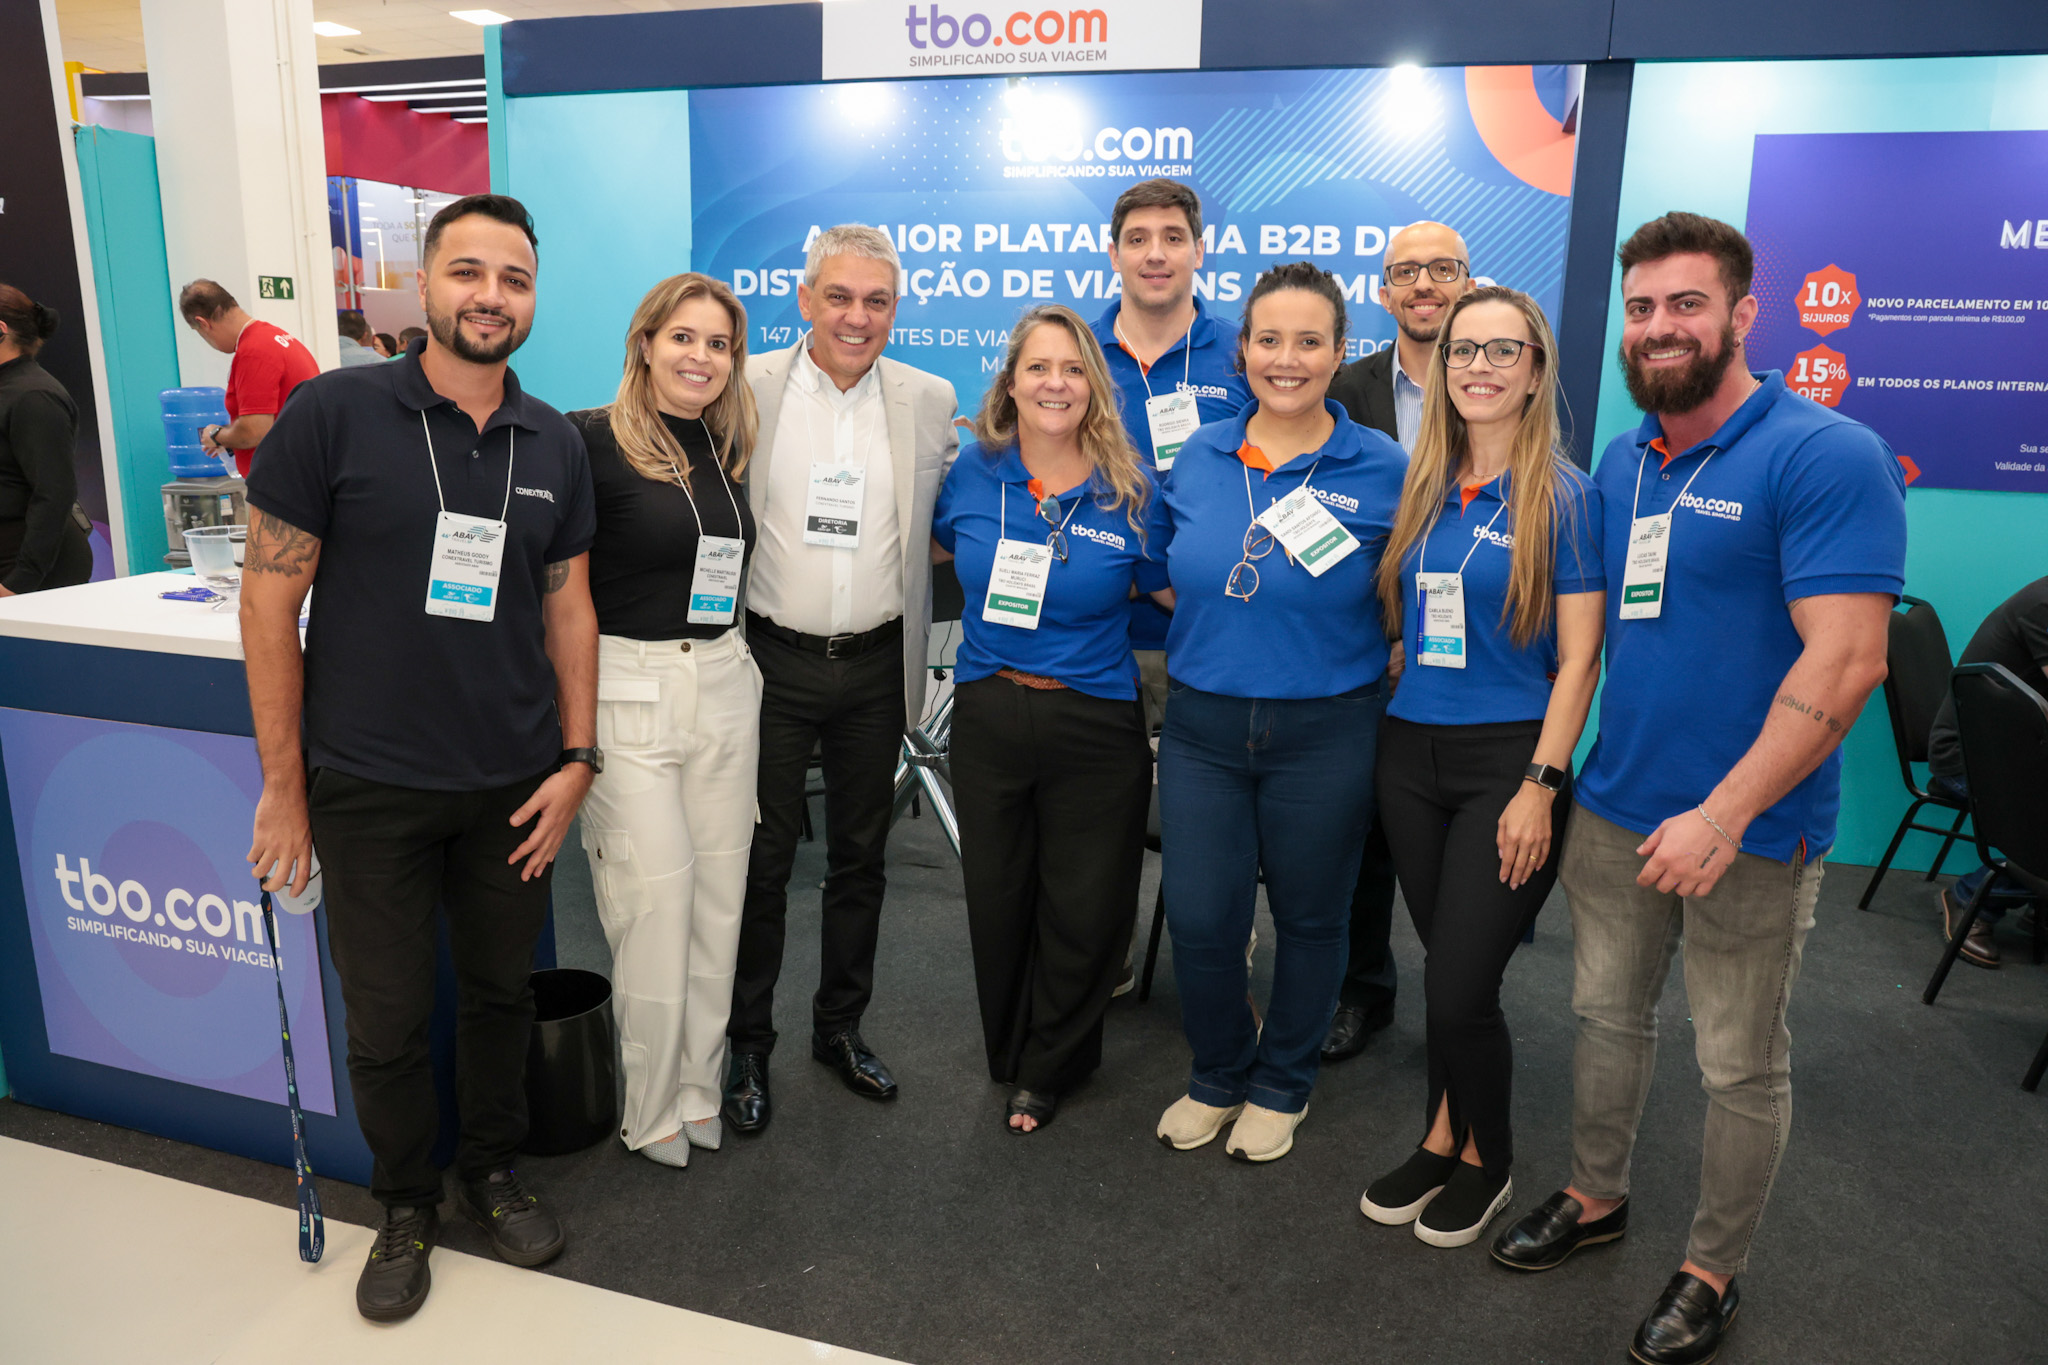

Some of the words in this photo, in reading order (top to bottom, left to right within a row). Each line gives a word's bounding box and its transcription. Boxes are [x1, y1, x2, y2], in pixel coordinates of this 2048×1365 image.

[905, 4, 1108, 49] tbo.com
[909, 52, 1016, 67] SIMPLIFICANDO
[1019, 51, 1048, 63] SUA
[1051, 49, 1107, 62] VIAGEM
[999, 118, 1194, 162] t.com
[1003, 164, 1106, 178] SIMPLIFICANDO
[1108, 165, 1136, 177] SUA
[1138, 164, 1192, 177] VIAGEM
[877, 224, 962, 252] AIOR
[1259, 224, 1342, 256] B2B
[1354, 225, 1406, 256] D
[733, 261, 990, 304] DISTIÇÃO
[1002, 269, 1054, 298] DE
[1064, 269, 1242, 301] VIANS
[1867, 297, 1904, 308] NOVO
[1907, 298, 2011, 311] PARCELAMENTO
[2013, 300, 2034, 311] EM
[1802, 313, 1850, 323] S/JUROS
[1928, 314, 1954, 323] parcela
[1955, 314, 1980, 323] mínima
[1981, 315, 1991, 323] de
[1991, 315, 2026, 324] R$100,00
[760, 327, 792, 343] 147
[940, 328, 970, 346] DE
[1795, 358, 1847, 384] 15%
[1857, 377, 1876, 387] EM
[1878, 377, 1922, 388] TODOS
[1923, 378, 1941, 389] OS
[1943, 379, 1994, 391] PLANOS
[1797, 387, 1832, 402] OFF
[1160, 406, 1176, 414] ABAV
[2020, 443, 2038, 453] Sua
[1994, 461, 2033, 471] Validade
[2034, 462, 2046, 472] da
[1680, 492, 1743, 516] tbo.com
[818, 517, 848, 526] DIRETORIA
[1695, 508, 1711, 516] TRAVEL
[1711, 511, 1741, 522] SIMPLIFIED
[452, 531, 477, 541] ABAV
[1071, 523, 1126, 547] tbo.com
[1473, 524, 1517, 547] tbo.c
[1640, 533, 1653, 541] ABAV
[1310, 536, 1338, 557] EXPOSITOR
[447, 549, 471, 557] MATHEUS
[471, 551, 490, 559] GODOY
[1009, 553, 1028, 561] ABAV
[442, 582, 482, 594] ASSOCIADO
[1631, 589, 1654, 598] EXPOSITOR
[998, 599, 1029, 610] EXPOSITOR
[1428, 636, 1456, 644] ASSOCIADO
[54, 853, 281, 948] tbo.com
[185, 938, 219, 958] SUA
[219, 945, 284, 971] VIAGEM
[295, 1157, 303, 1176] BeFly
[311, 1237, 320, 1260] LYTOUR
